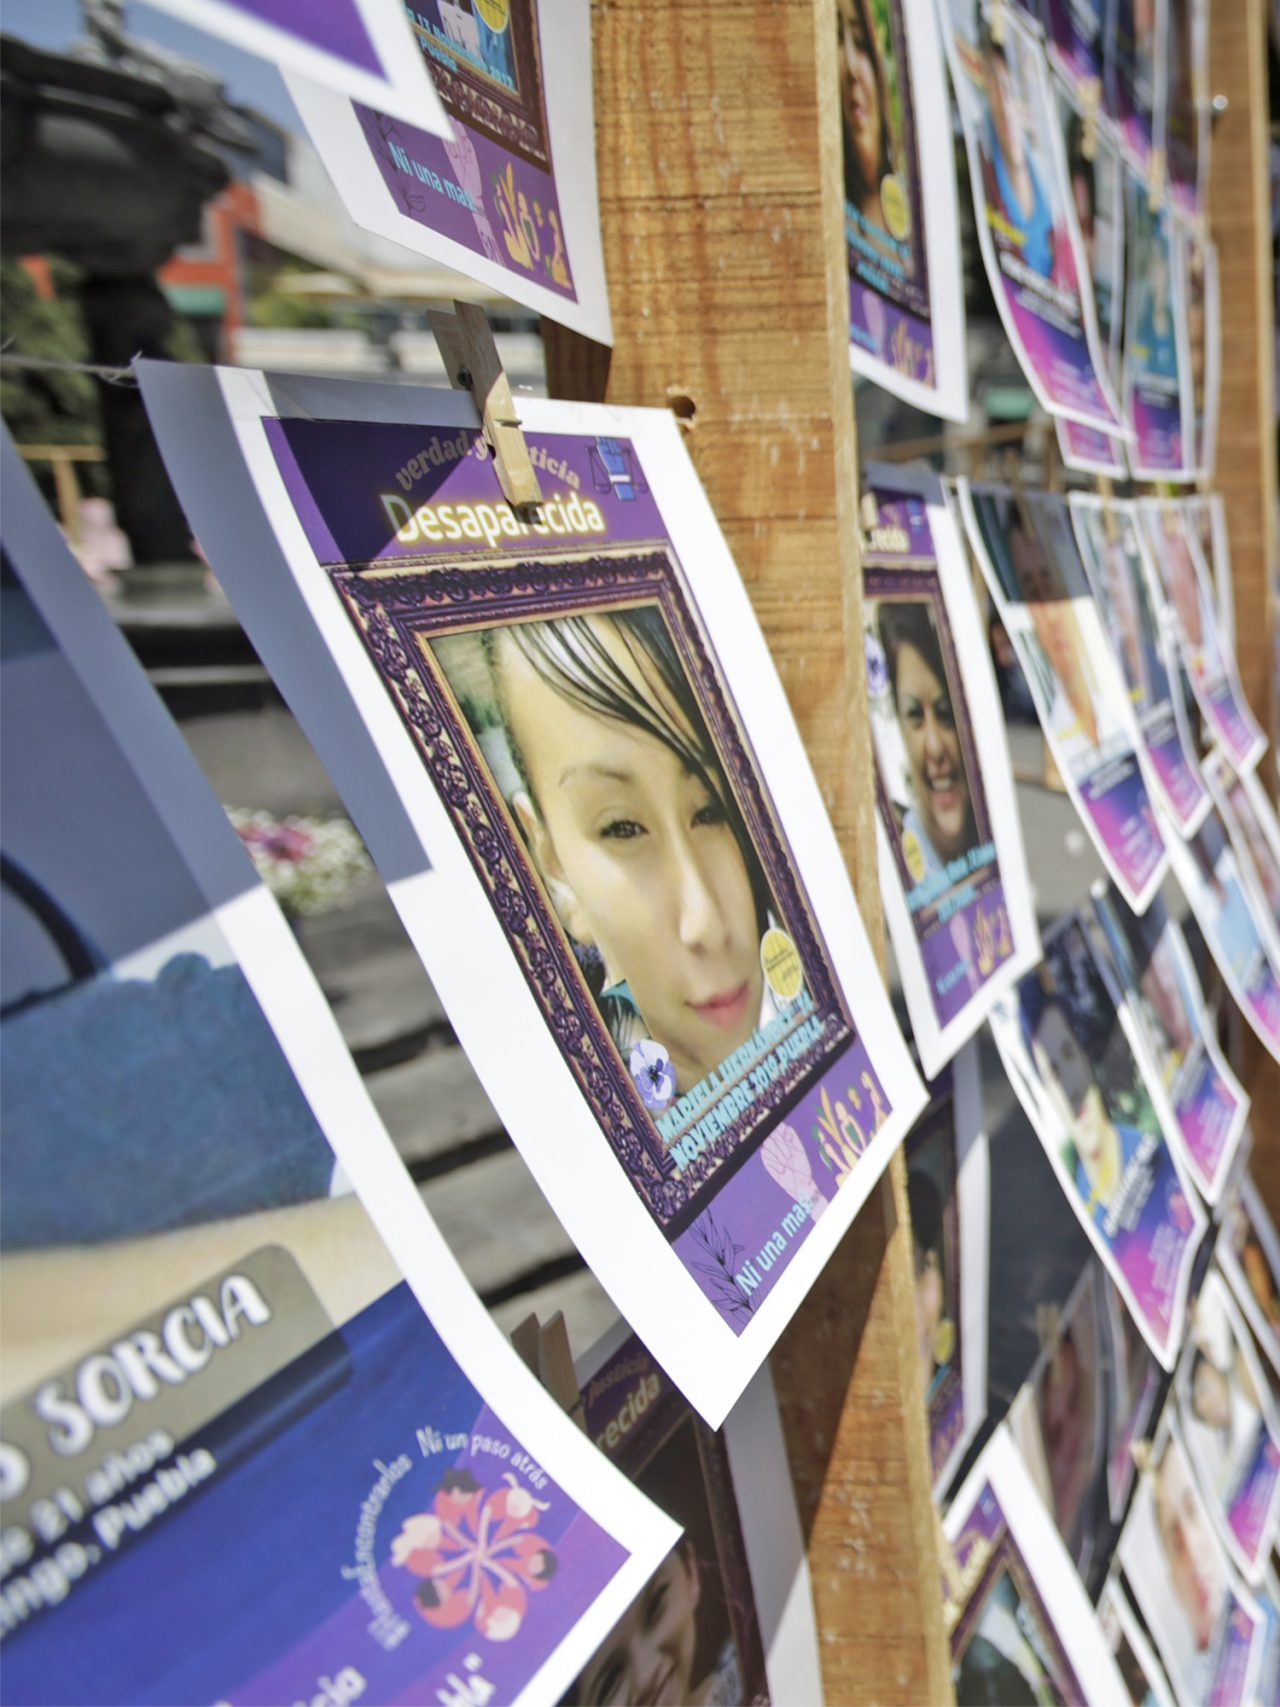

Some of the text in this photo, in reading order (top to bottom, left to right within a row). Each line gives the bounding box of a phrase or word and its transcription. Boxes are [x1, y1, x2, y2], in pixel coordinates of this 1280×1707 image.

[387, 141, 414, 176] Ni
[412, 160, 444, 193] una
[396, 430, 472, 492] verdad
[655, 1070, 724, 1143] MARIELA
[669, 1079, 756, 1172] NOVIEMBRE
[735, 1259, 763, 1296] Ni
[755, 1231, 788, 1271] una
[36, 1274, 272, 1456] SORCIA
[415, 1425, 443, 1458] Ni
[444, 1432, 469, 1451] un
[470, 1434, 511, 1458] paso
[510, 1451, 551, 1491] atrás
[92, 1448, 217, 1550] Puebla
